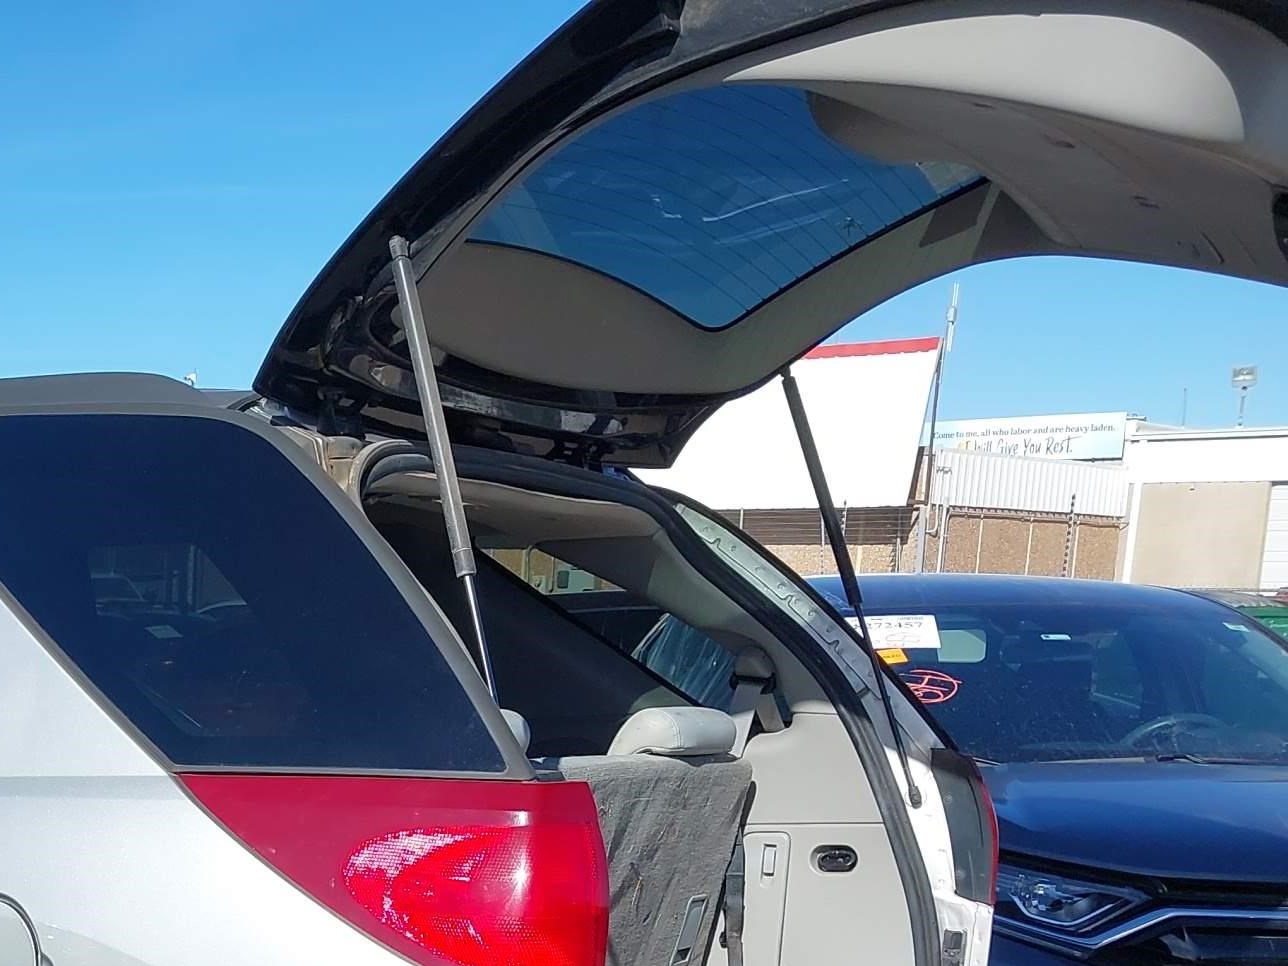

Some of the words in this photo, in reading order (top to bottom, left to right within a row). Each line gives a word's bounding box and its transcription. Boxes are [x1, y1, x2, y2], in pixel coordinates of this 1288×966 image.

[981, 428, 991, 437] all
[993, 427, 1009, 437] who
[1011, 426, 1031, 435] labor
[1033, 425, 1049, 434] and
[1065, 424, 1089, 434] heavy
[1023, 438, 1042, 456] You
